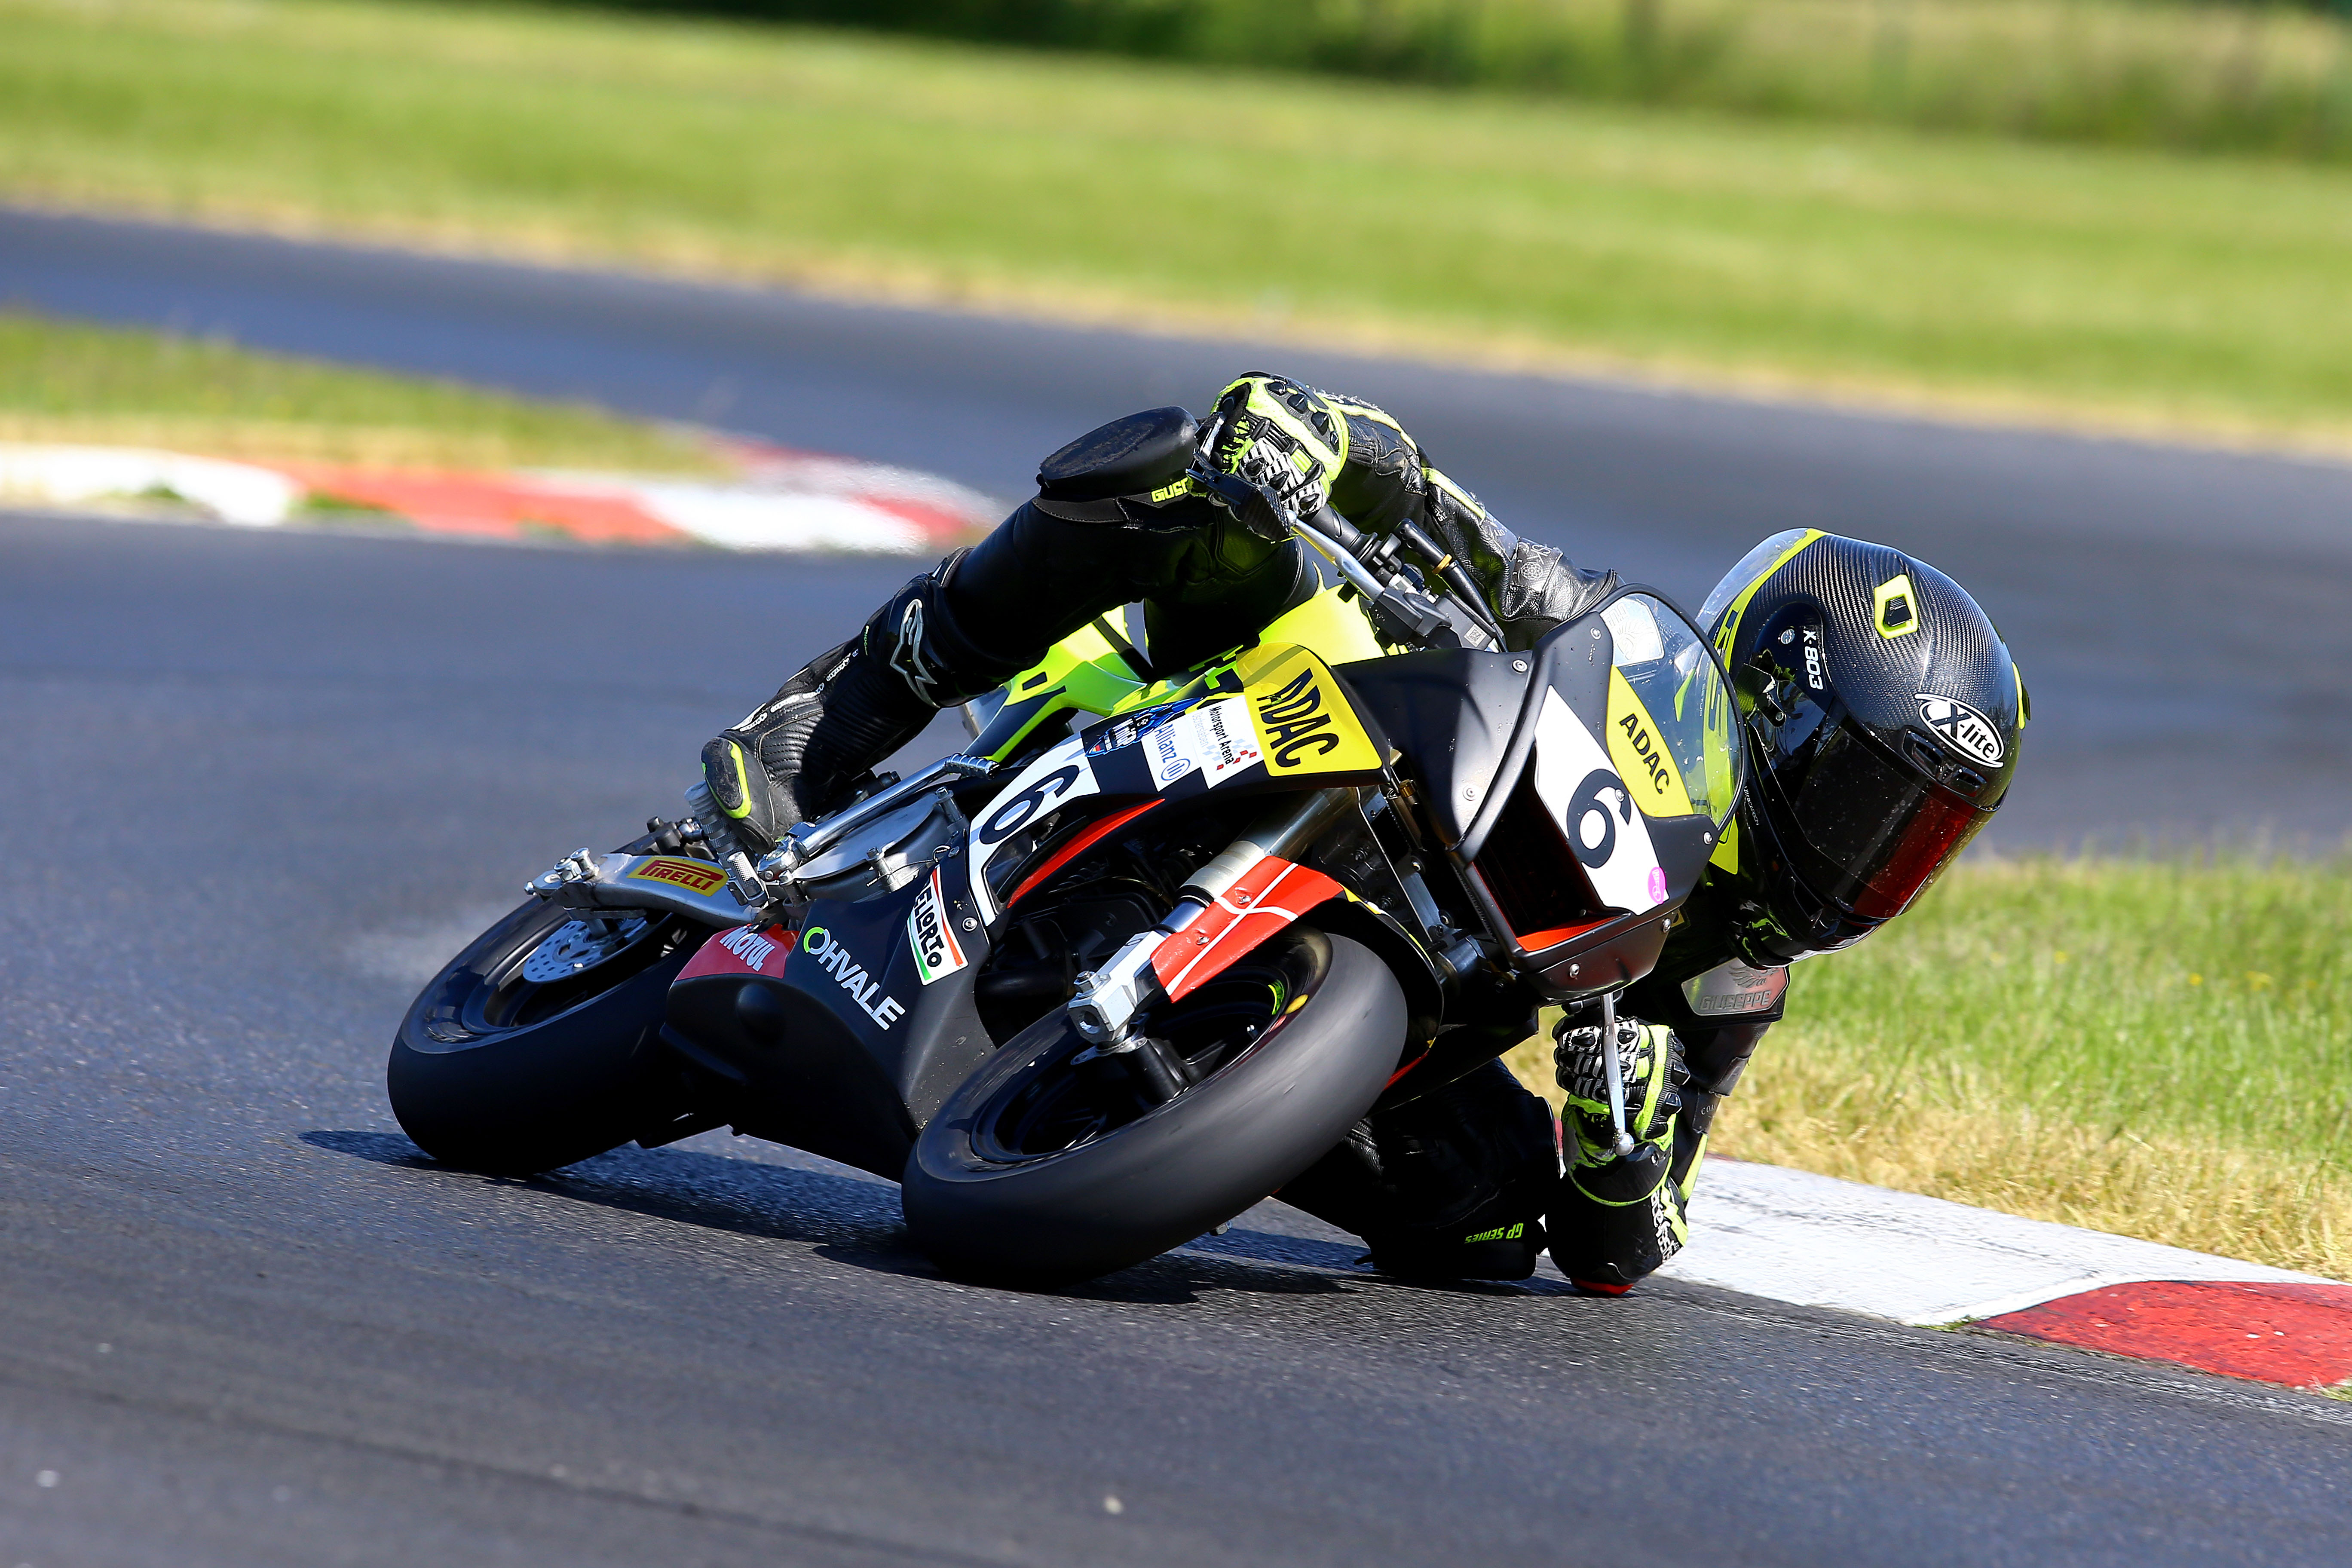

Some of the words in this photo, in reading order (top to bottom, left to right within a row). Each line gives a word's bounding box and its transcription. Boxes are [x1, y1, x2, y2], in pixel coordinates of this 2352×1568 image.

[1803, 629, 1823, 690] X-803
[1154, 723, 1177, 763] Allianz
[1209, 705, 1229, 741] Motorsport
[1219, 740, 1234, 765] Arena
[1256, 668, 1339, 769] ADAC
[1930, 701, 1995, 759] X-lite
[1618, 713, 1670, 795] ADAC
[979, 765, 1080, 845] 6
[1566, 769, 1632, 869] 6
[639, 859, 726, 894] PIRELLI
[719, 925, 775, 972] MOTUL
[914, 885, 945, 968] ELLORTO
[802, 927, 906, 1030] OHVALE
[1464, 1226, 1505, 1244] SERIES
[1505, 1222, 1524, 1239] GP
